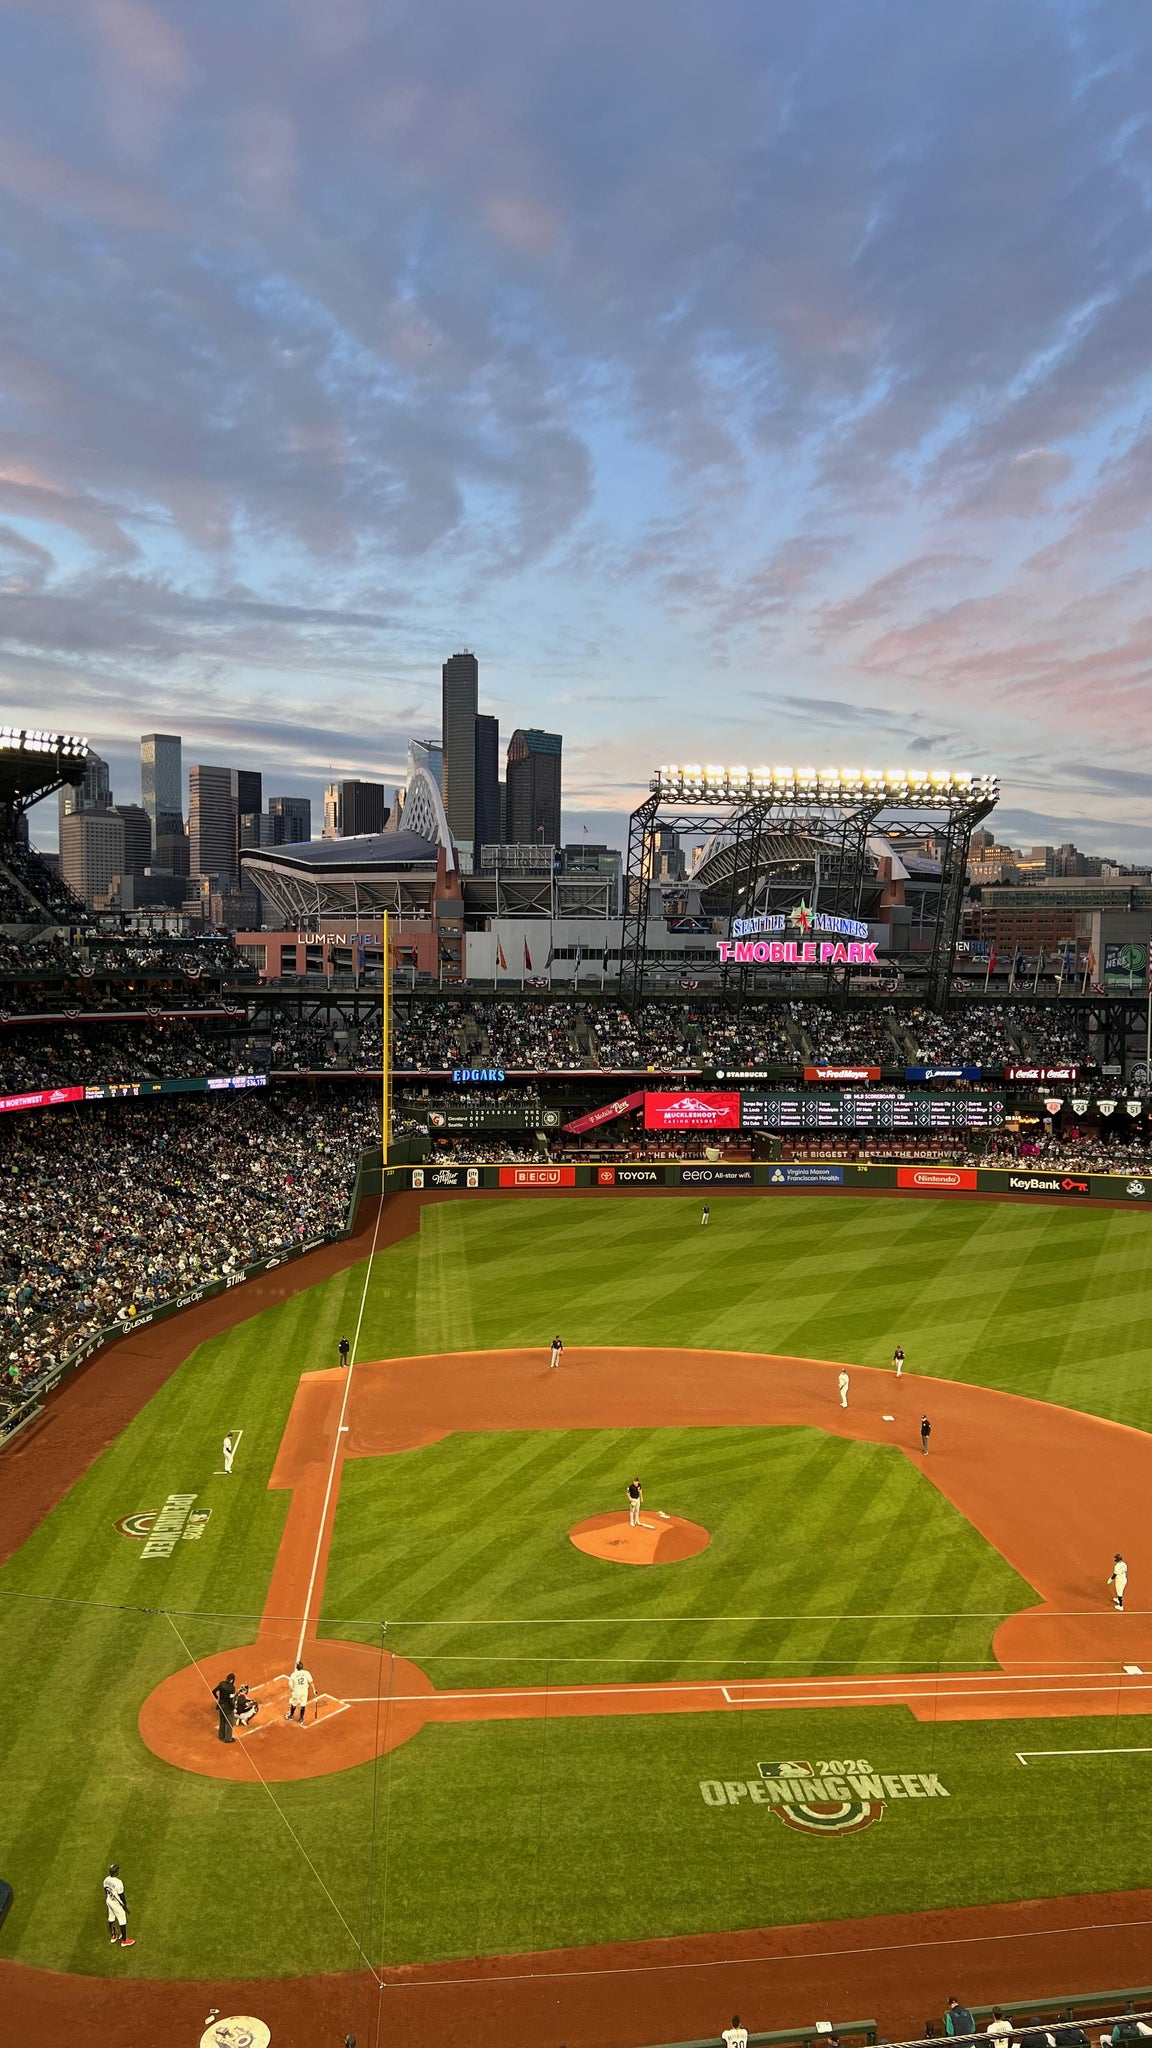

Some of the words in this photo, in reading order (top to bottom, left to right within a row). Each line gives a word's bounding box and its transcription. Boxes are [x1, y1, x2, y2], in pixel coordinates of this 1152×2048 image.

[732, 914, 785, 937] SEATTLE
[814, 913, 868, 938] MARINERS
[298, 934, 346, 944] LUMEN
[717, 942, 817, 963] T-MOBILE
[820, 942, 879, 963] PARK
[452, 1068, 505, 1082] EDGAR'S
[1016, 1070, 1039, 1079] Coca-Cola
[1046, 1070, 1070, 1079] Coca-Cola
[6, 1096, 43, 1108] NORTHWEST
[519, 1173, 557, 1181] BECU
[618, 1172, 657, 1180] TOYOTA
[682, 1170, 712, 1181] eero
[918, 1174, 956, 1183] Nintendo
[1010, 1177, 1060, 1190] KeyBank
[1130, 1183, 1142, 1191] 50
[226, 1271, 246, 1288] STIHL
[176, 1294, 190, 1308] Great
[190, 1291, 203, 1303] Clips
[131, 1314, 153, 1329] LEXUS
[816, 1759, 873, 1776] 2026
[699, 1778, 852, 1806] OPENING
[850, 1773, 951, 1800] WEEK
[732, 2040, 744, 2048] 30
